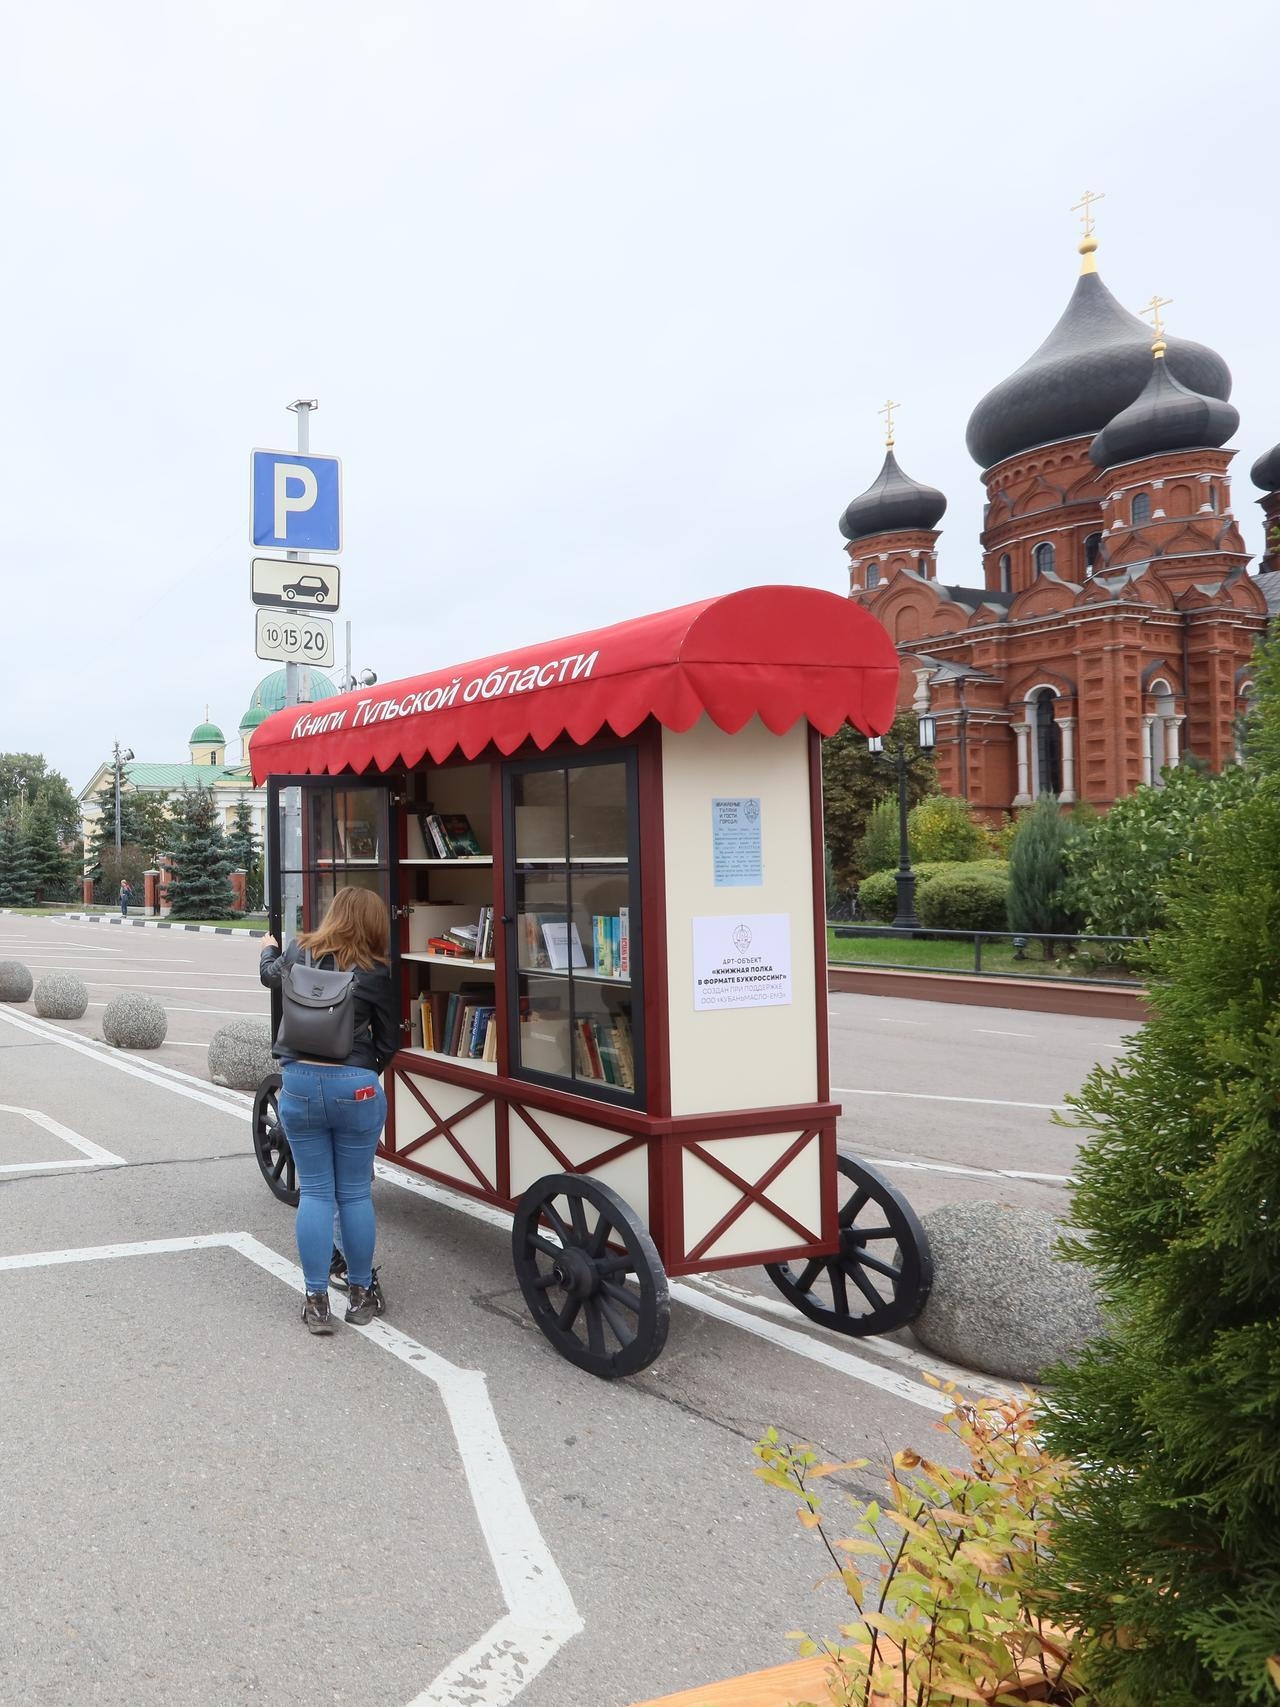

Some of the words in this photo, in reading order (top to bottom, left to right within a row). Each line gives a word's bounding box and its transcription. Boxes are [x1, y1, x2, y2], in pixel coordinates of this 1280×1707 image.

[273, 462, 319, 540] P
[266, 627, 279, 642] 10
[283, 629, 298, 647] 15
[303, 630, 326, 652] 20
[291, 709, 347, 740] Книги
[352, 676, 464, 728] Тульской
[464, 650, 600, 703] области
[722, 956, 762, 965] АРТ-ОБЪЕКТ
[711, 967, 750, 975] «КНИЖНАЯ
[750, 965, 773, 973] ПОЛКА
[703, 977, 736, 985] ФОРМАТЕ
[736, 974, 787, 983] БУККРОССИНГ»
[702, 986, 729, 995] СОЗДАН
[730, 985, 744, 993] ПРИ
[744, 983, 783, 992] ПОДДЕРЖКЕ
